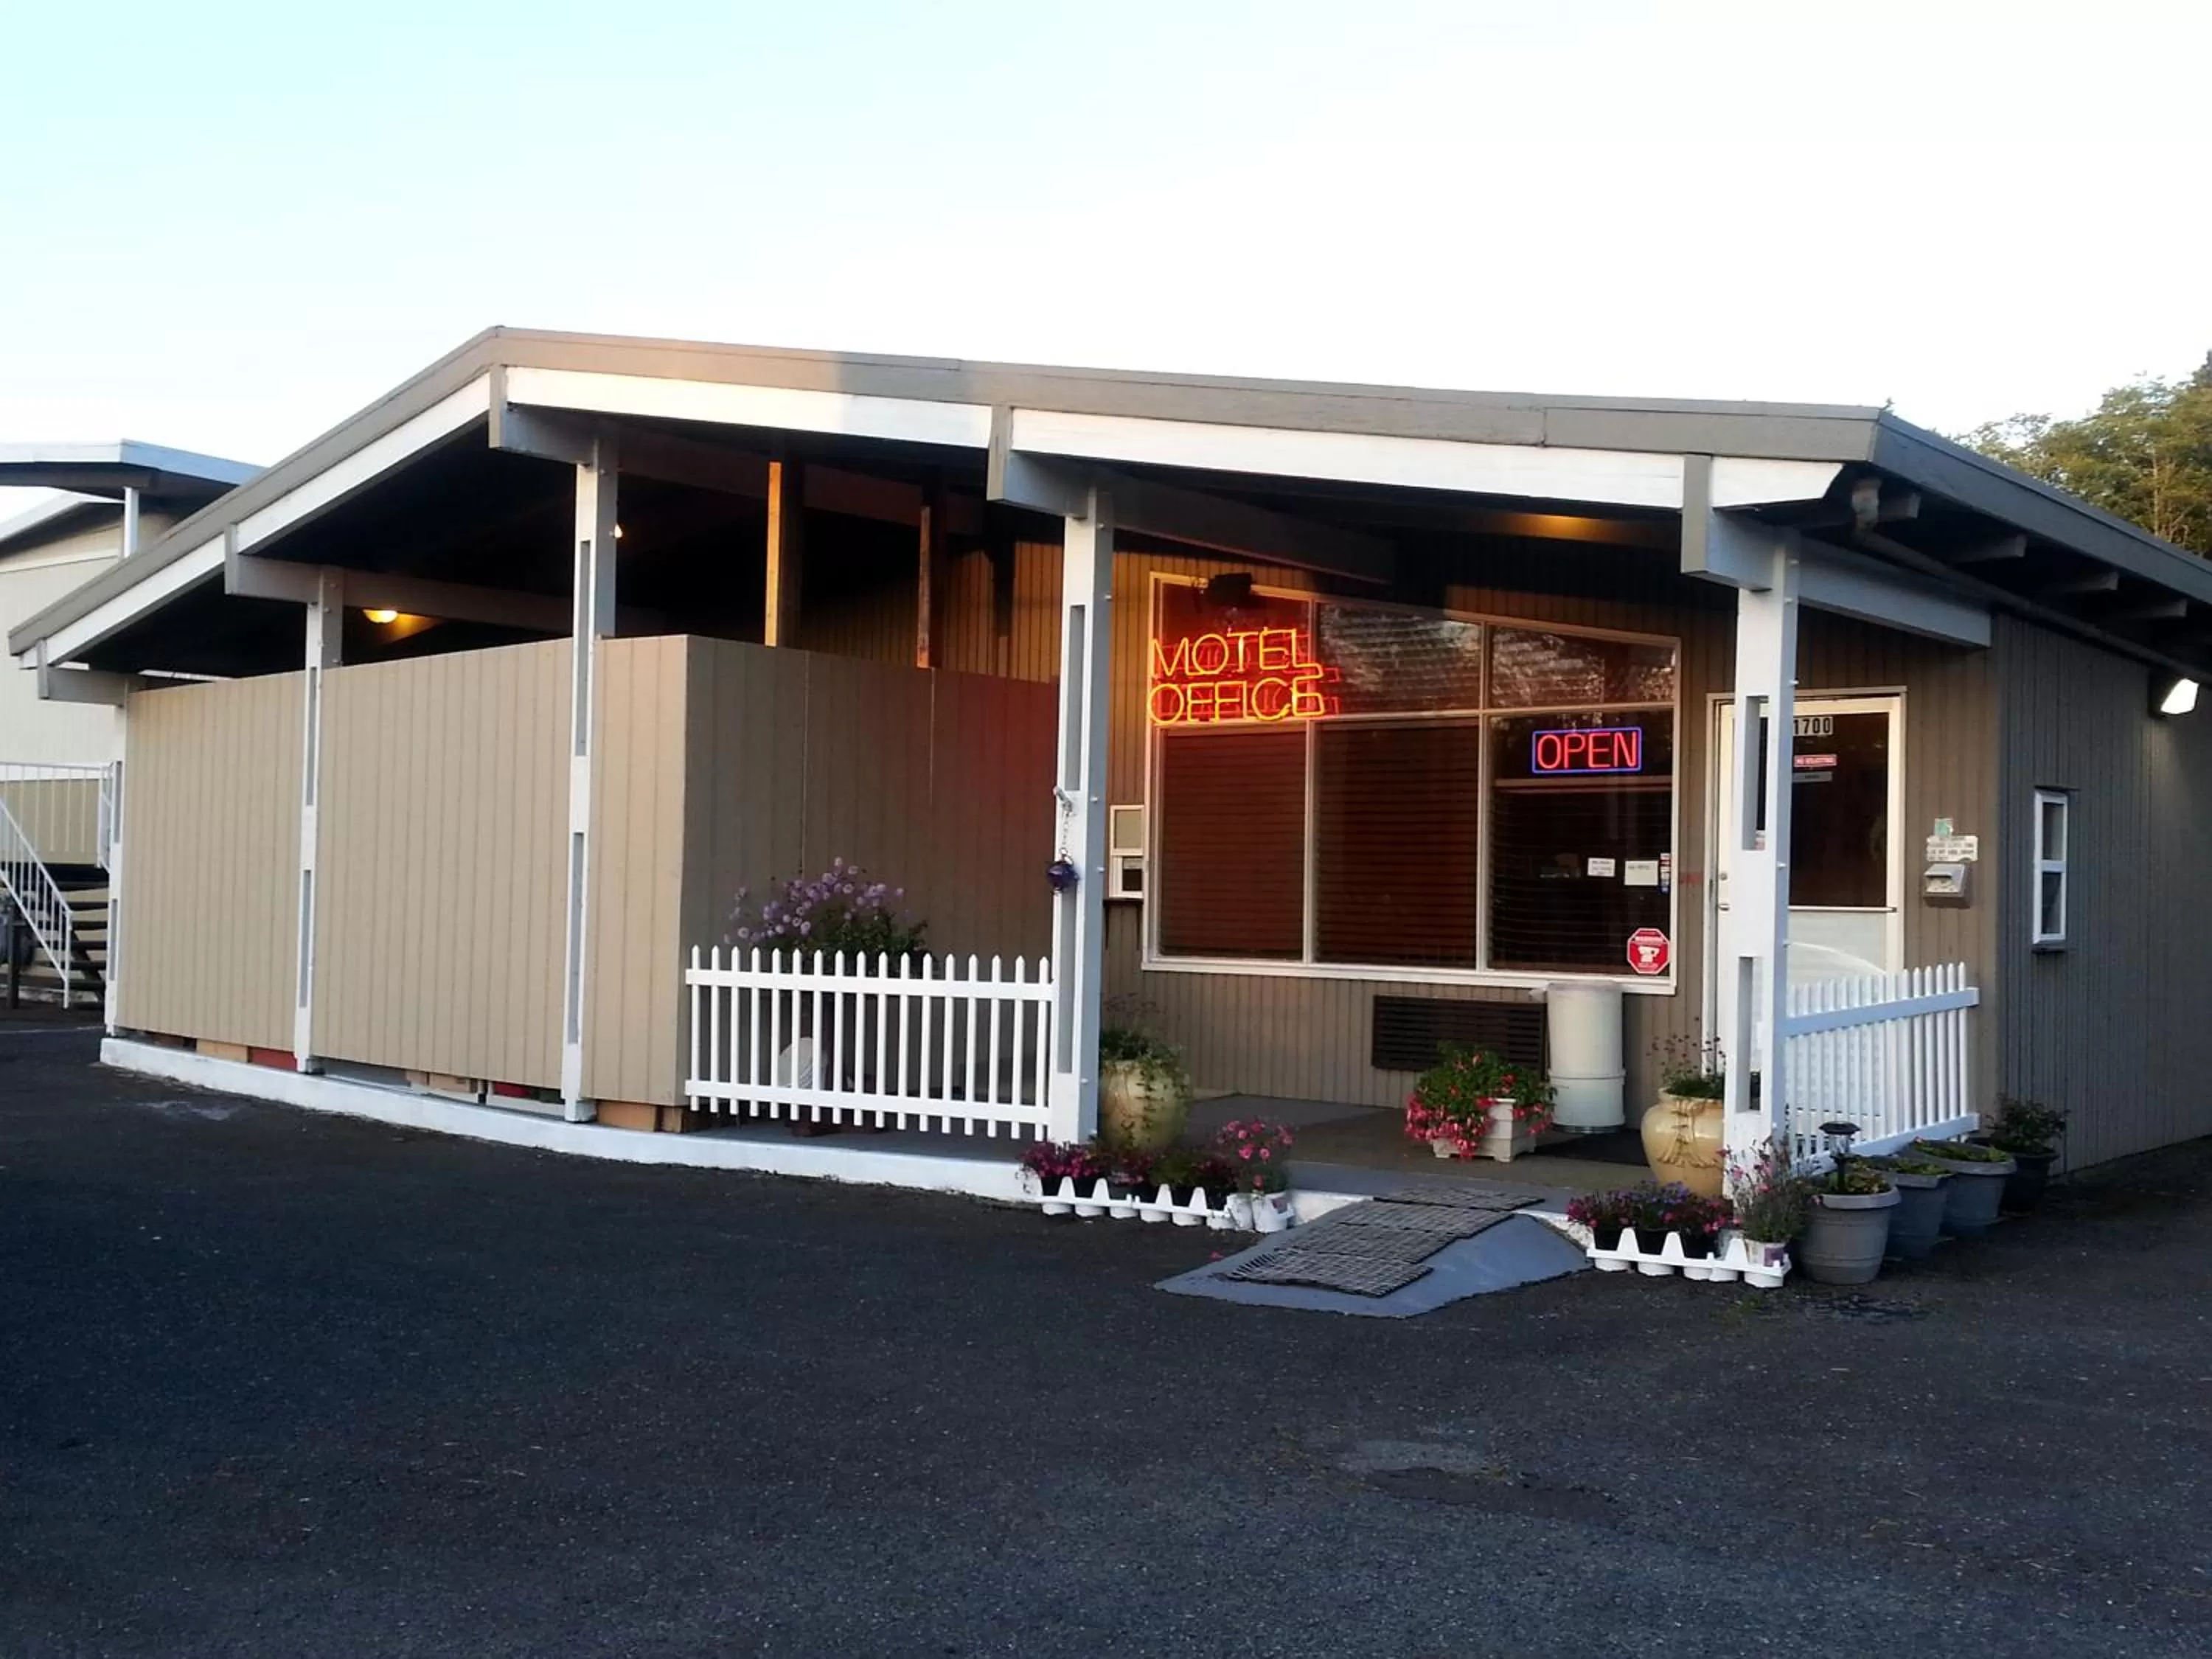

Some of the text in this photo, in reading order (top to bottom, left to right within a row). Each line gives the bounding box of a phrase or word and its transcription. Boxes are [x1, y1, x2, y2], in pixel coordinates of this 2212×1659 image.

[1151, 627, 1321, 677] MOTEL
[1147, 677, 1325, 724] OFFICE
[1793, 717, 1831, 735] 1700
[1537, 731, 1637, 769] OPEN
